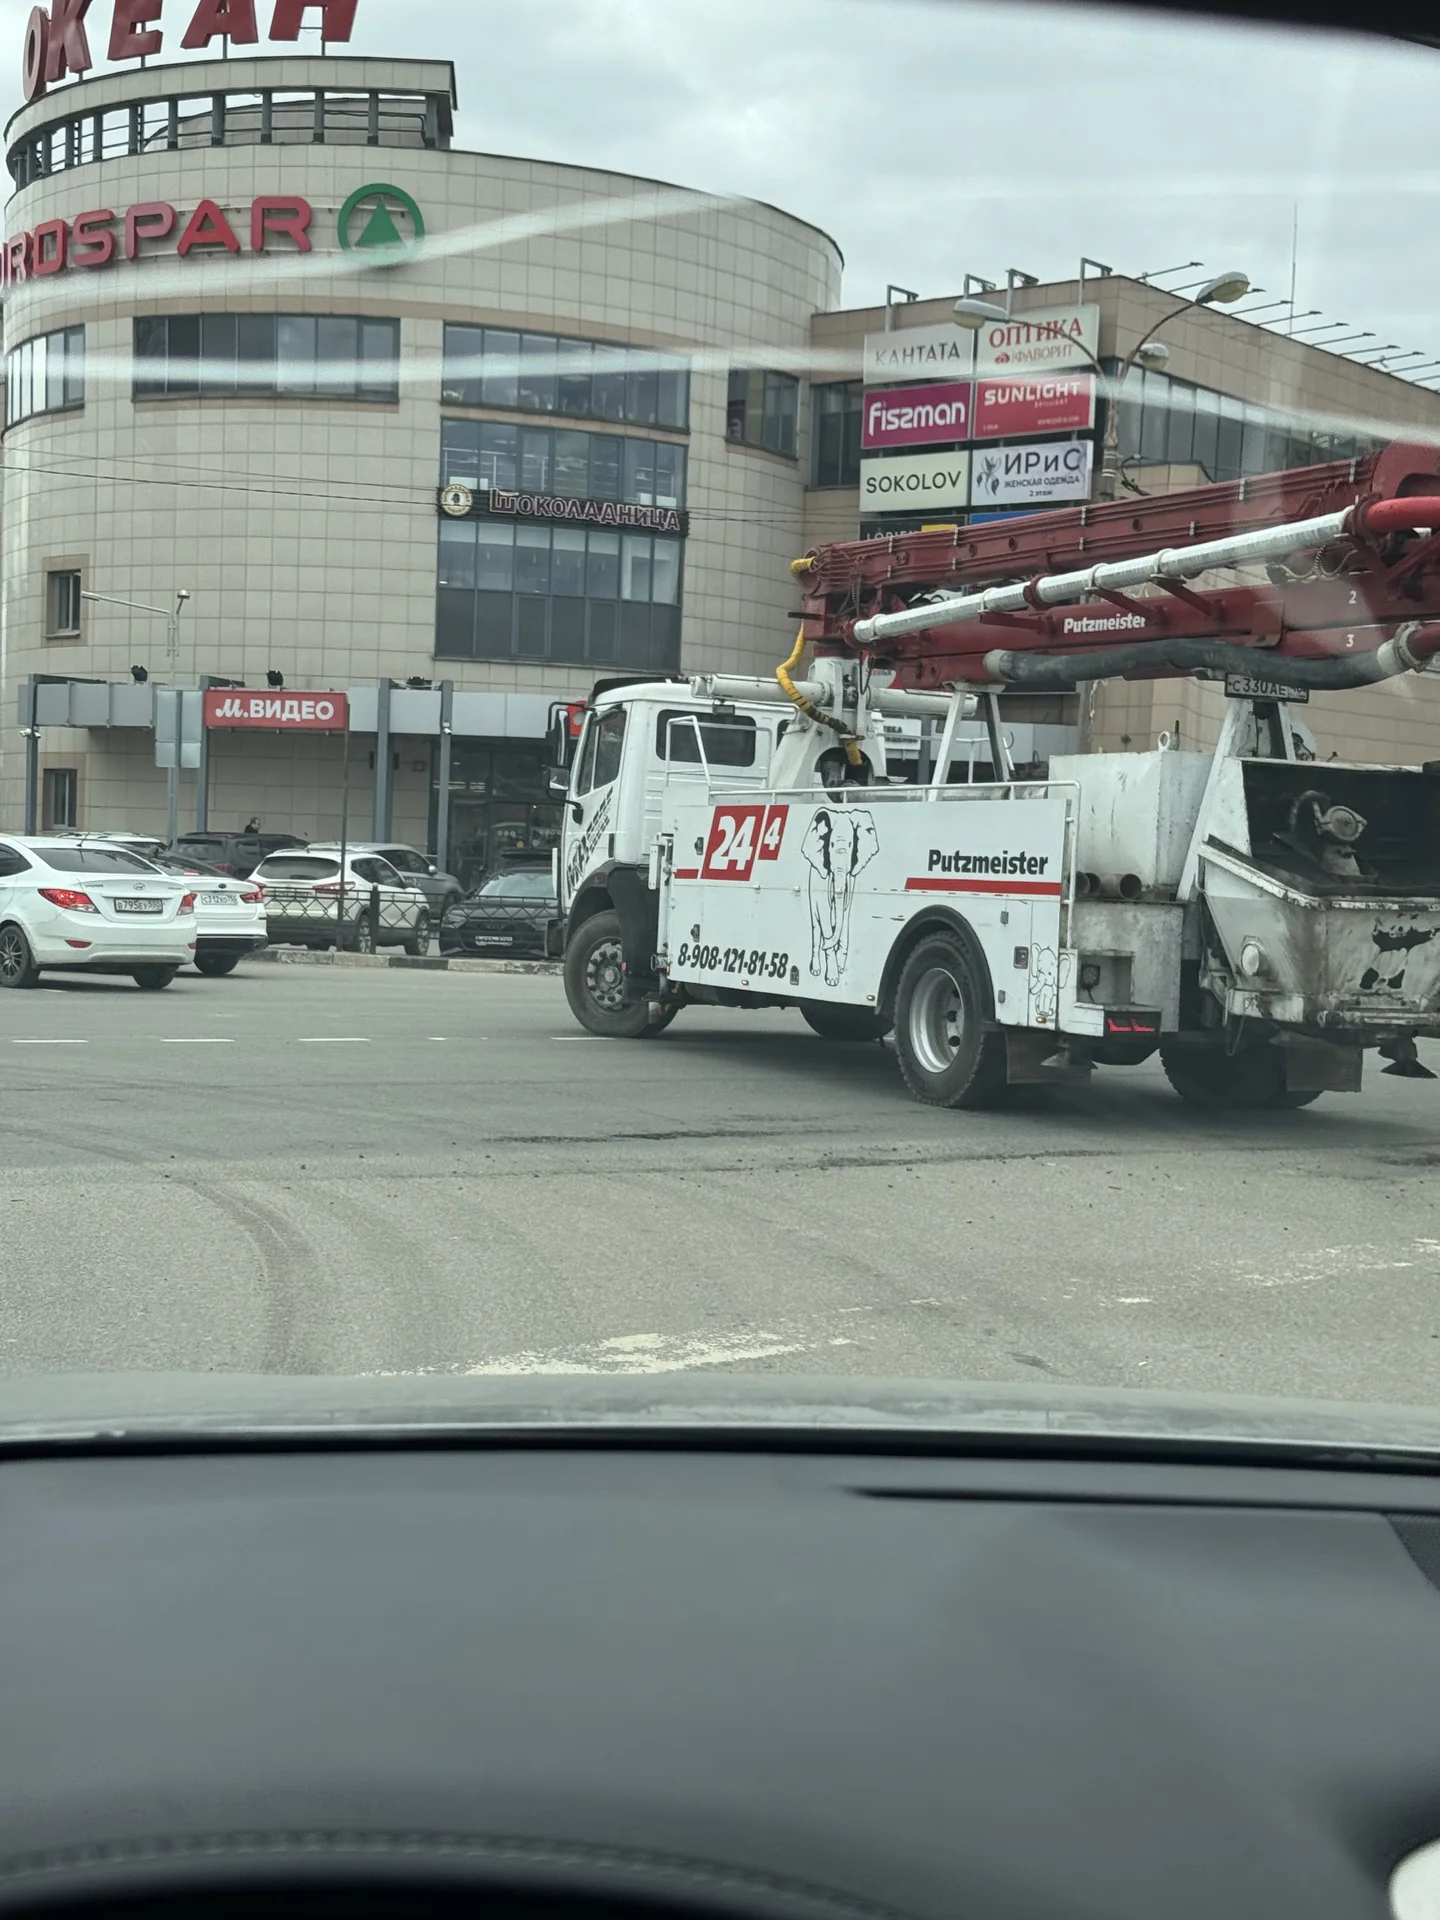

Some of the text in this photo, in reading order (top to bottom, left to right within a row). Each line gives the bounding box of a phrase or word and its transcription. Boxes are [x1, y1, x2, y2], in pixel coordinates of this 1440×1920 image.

[989, 317, 1083, 348] ОПТИКА
[875, 341, 960, 367] КАНТАТА
[984, 381, 1080, 406] SUNLIGHT
[866, 470, 962, 494] SOKOLOV
[1004, 475, 1079, 488] ЖЕНСКАЯ ОДЕЖДА
[489, 487, 680, 531] ШОКОЛАДНИЦА
[1348, 590, 1357, 604] 2
[1063, 611, 1147, 634] Putzmeister
[1346, 634, 1355, 648] 3
[708, 815, 756, 872] 24
[928, 848, 1049, 876] Putzmeister
[677, 942, 790, 980] 8-908-121-81-58
